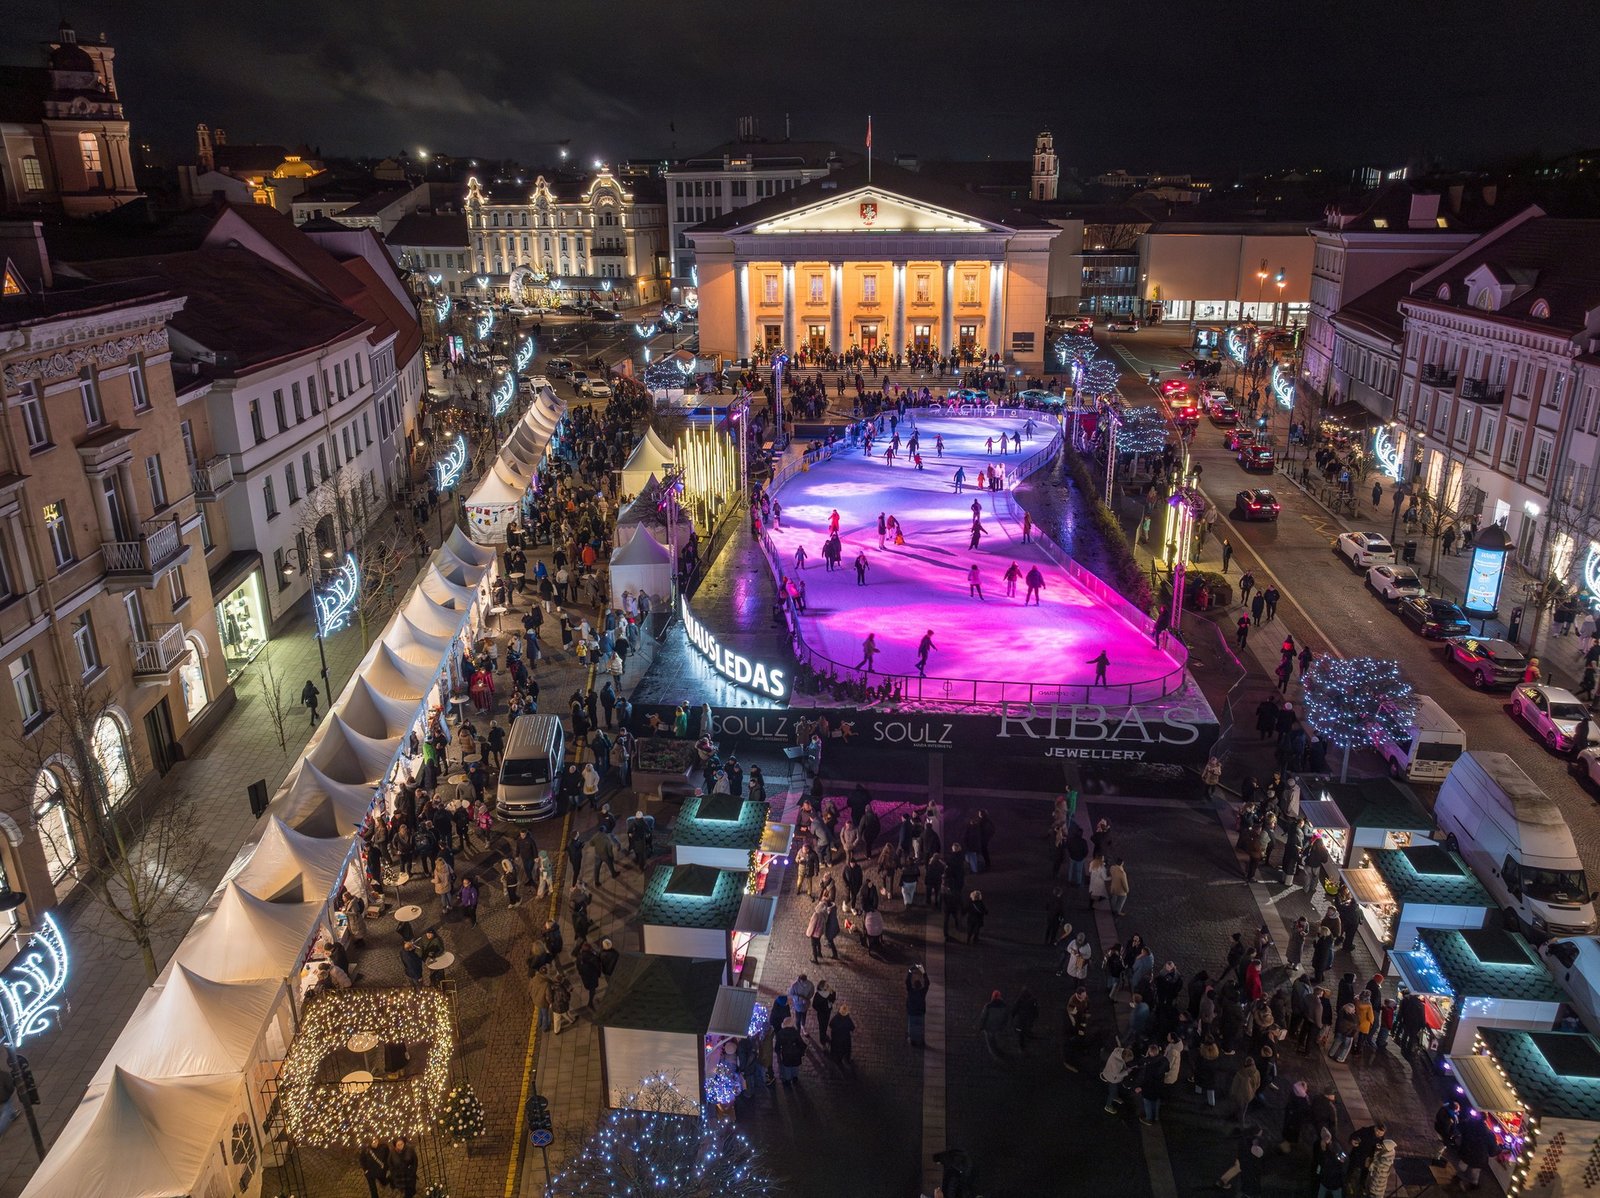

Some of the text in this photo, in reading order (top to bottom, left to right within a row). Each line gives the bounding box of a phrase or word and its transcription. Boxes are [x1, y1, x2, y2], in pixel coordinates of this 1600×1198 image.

[715, 643, 785, 696] LEDAS
[712, 715, 788, 738] SOULZ
[873, 721, 953, 744] SOULZ
[996, 700, 1200, 745] RIBAS
[1044, 747, 1146, 761] JEWELLERY
